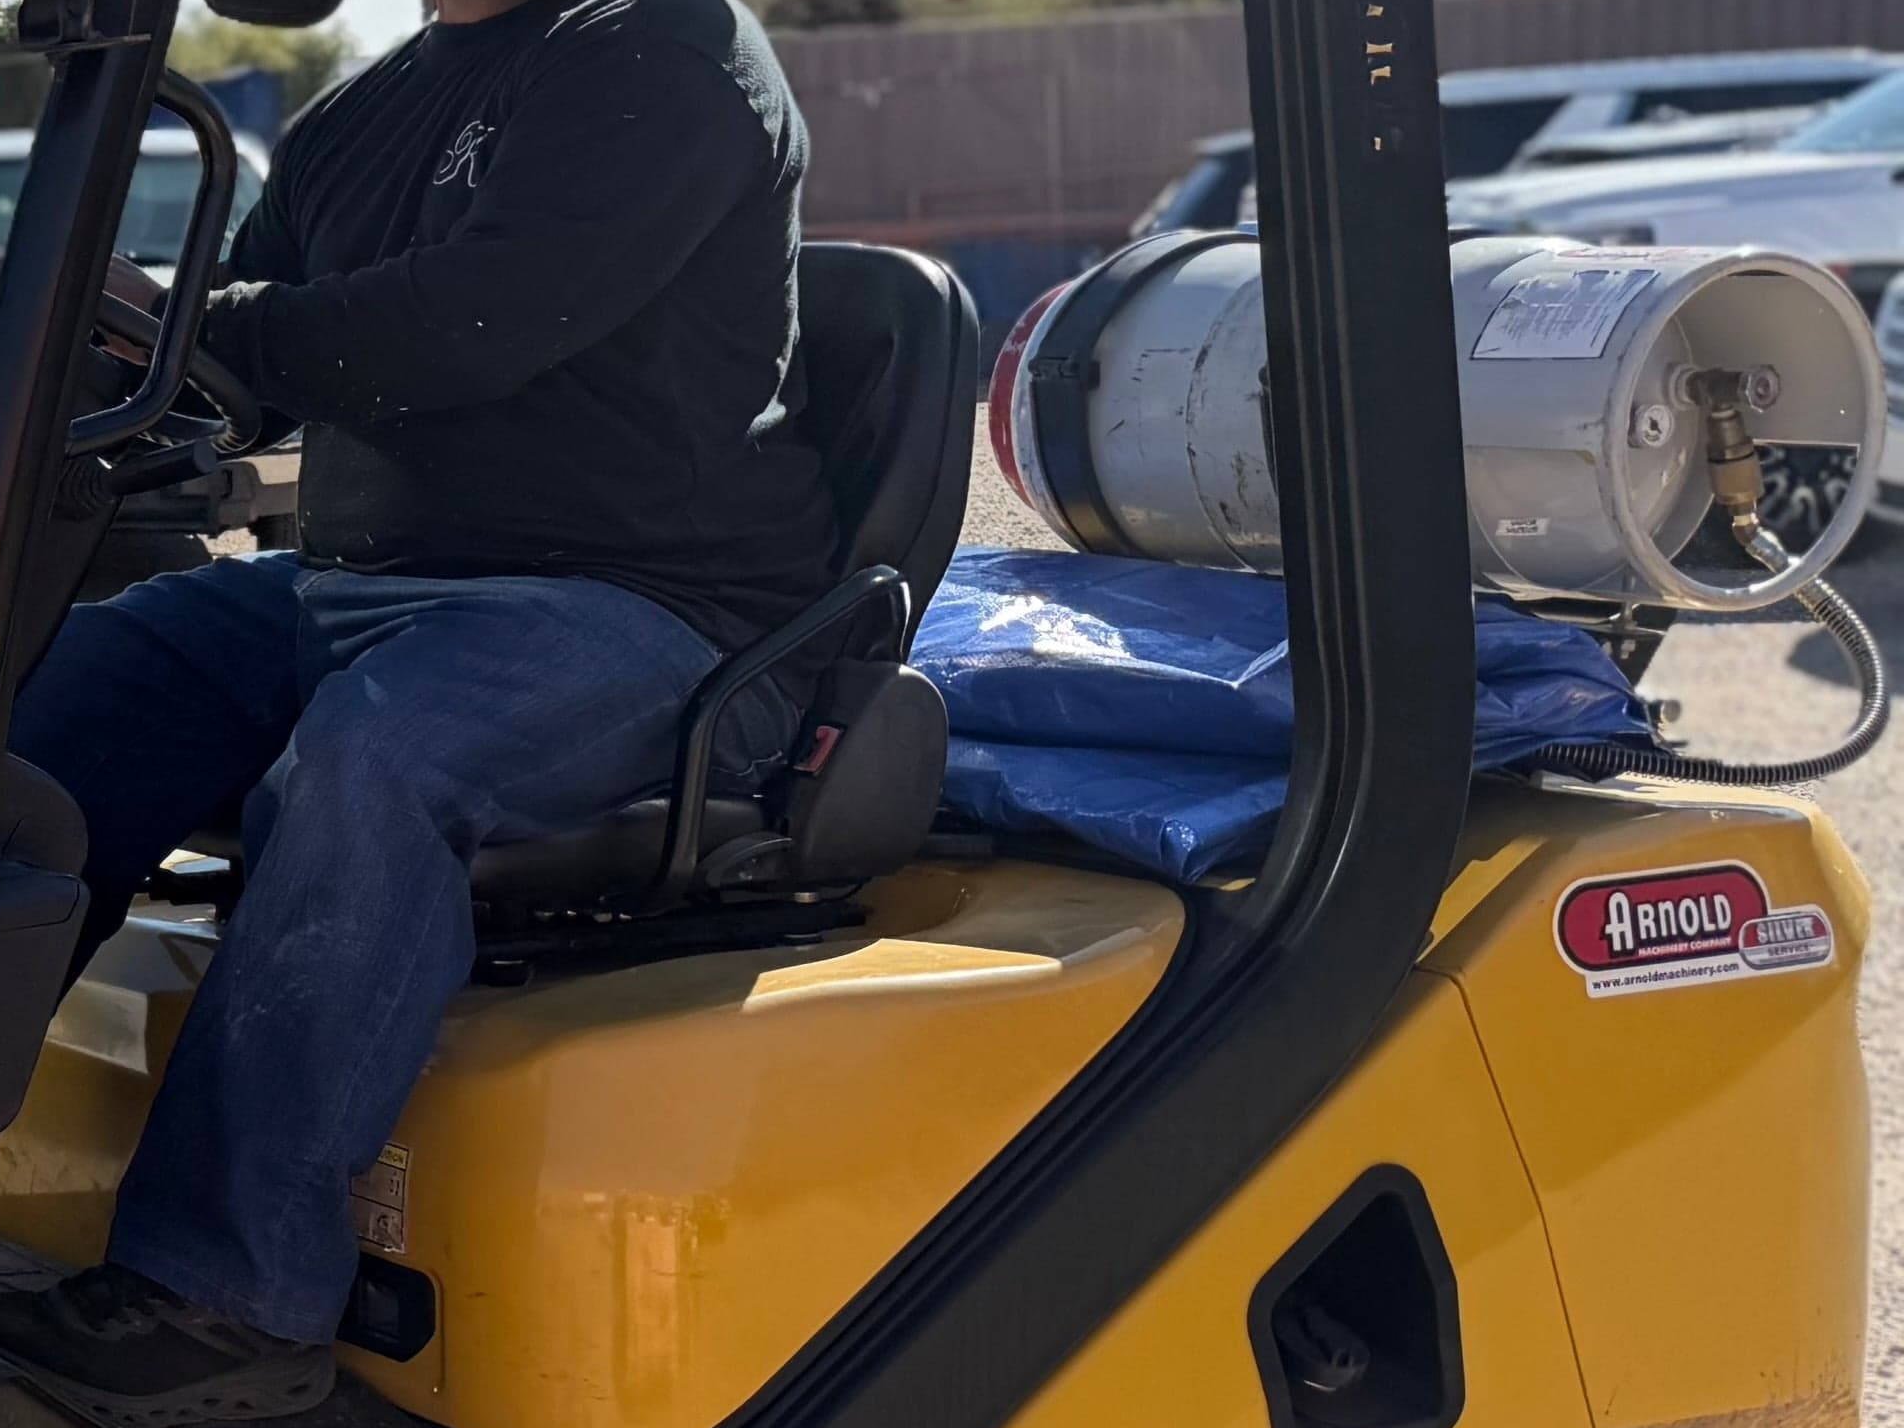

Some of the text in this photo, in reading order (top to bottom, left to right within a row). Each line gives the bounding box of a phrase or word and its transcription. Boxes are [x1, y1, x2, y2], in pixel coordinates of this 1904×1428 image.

[1604, 891, 1732, 952] ARNOLD
[1757, 917, 1814, 944] SILVER
[1638, 937, 1732, 957] MACHINERY COMPANY
[1592, 962, 1740, 990] www.arnoldmachinery.com
